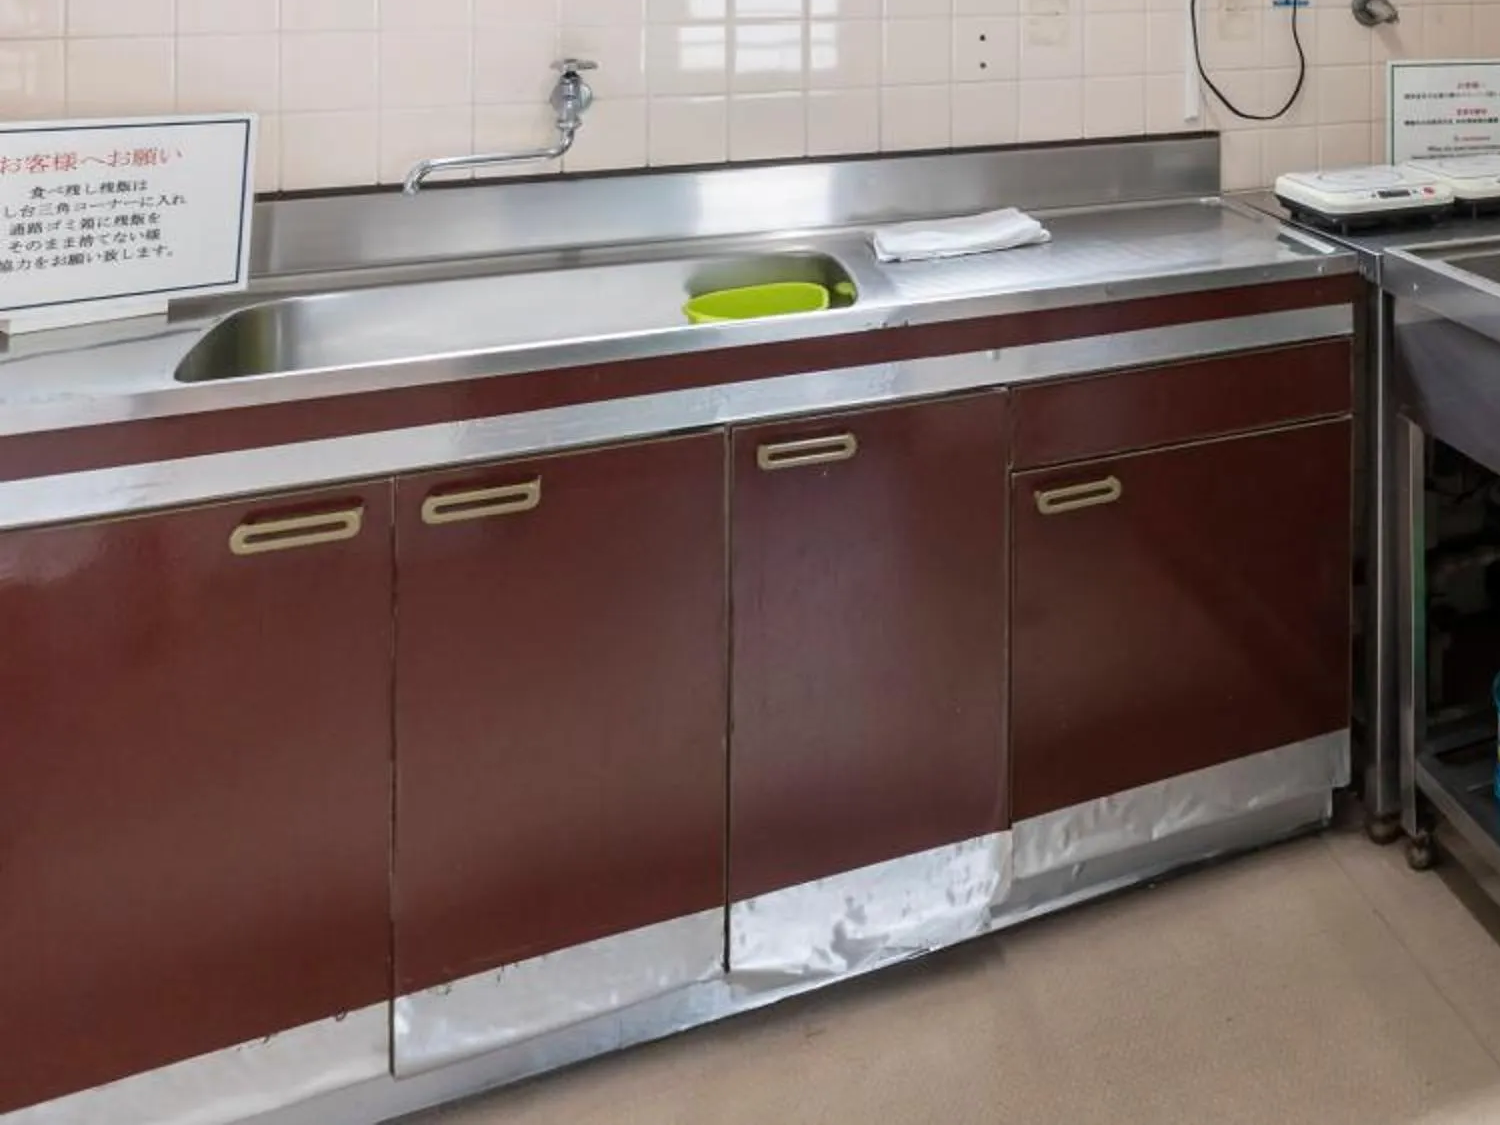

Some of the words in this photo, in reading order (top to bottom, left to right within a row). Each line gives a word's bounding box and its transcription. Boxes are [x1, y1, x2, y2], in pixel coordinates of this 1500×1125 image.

[0, 147, 184, 175] お客様へお願い
